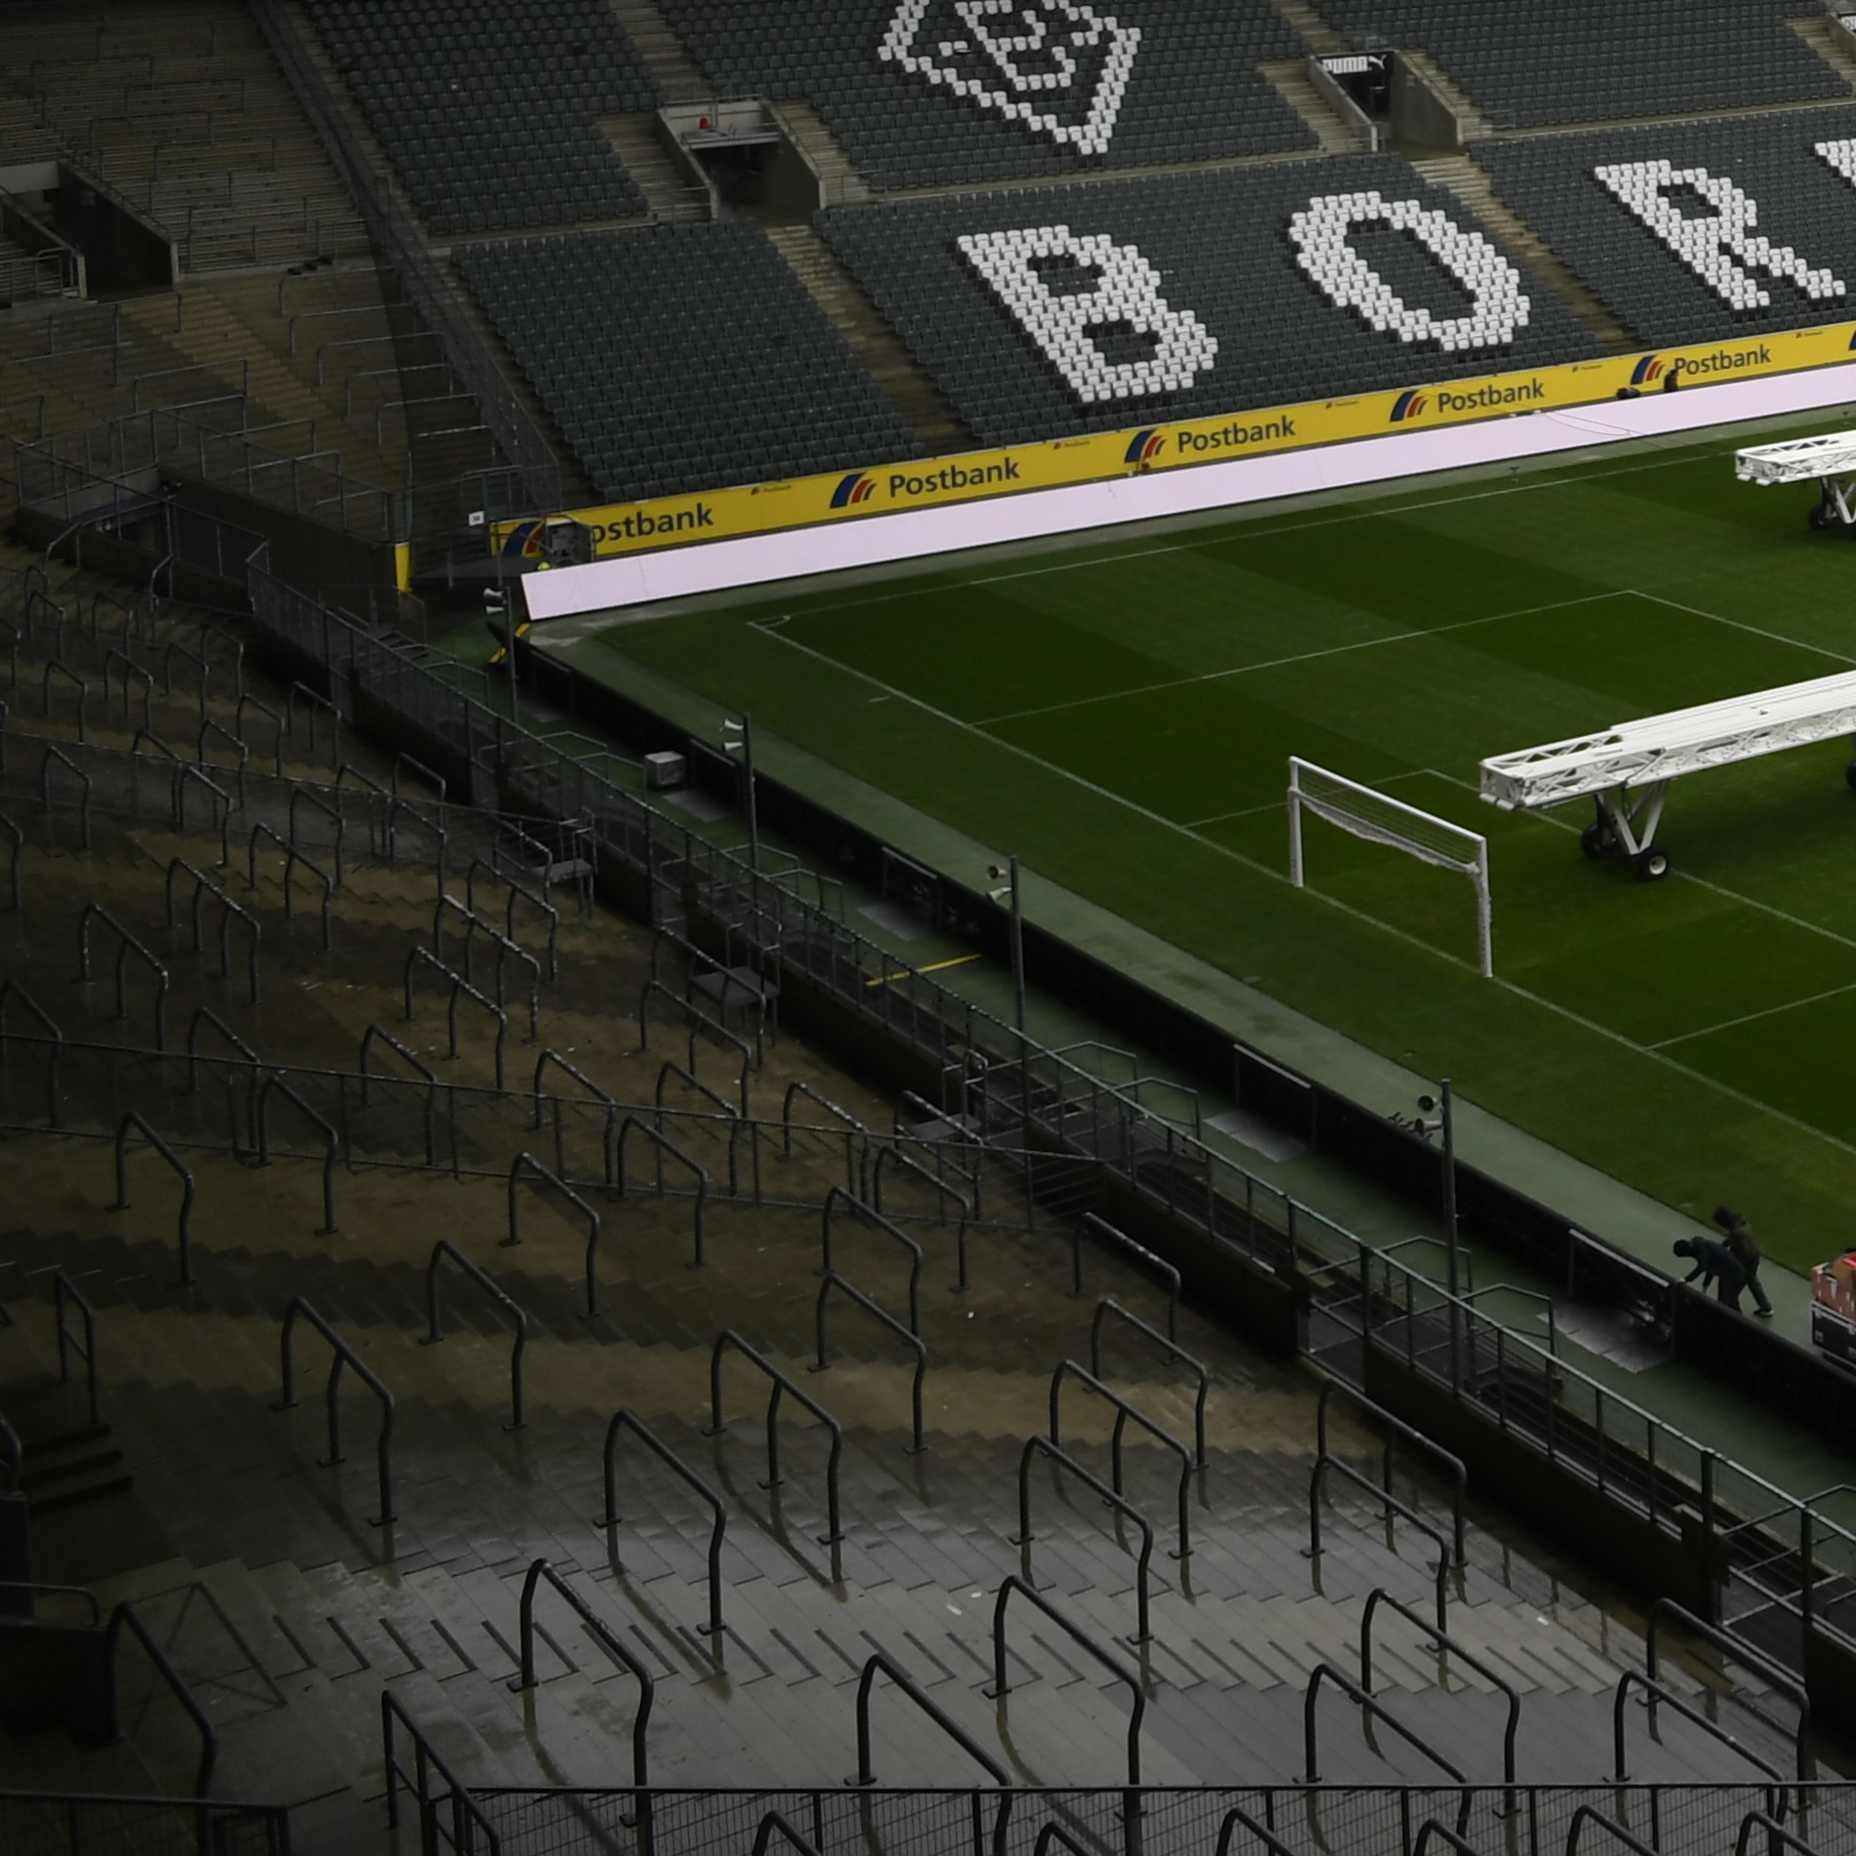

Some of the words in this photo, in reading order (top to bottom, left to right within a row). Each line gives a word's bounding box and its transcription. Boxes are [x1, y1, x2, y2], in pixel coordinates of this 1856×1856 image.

[1675, 346, 1771, 377] Postbank
[1437, 378, 1546, 412] Postbank
[1177, 414, 1296, 454] Postbank
[889, 457, 1021, 504] Postbank
[591, 501, 715, 545] ostbank
